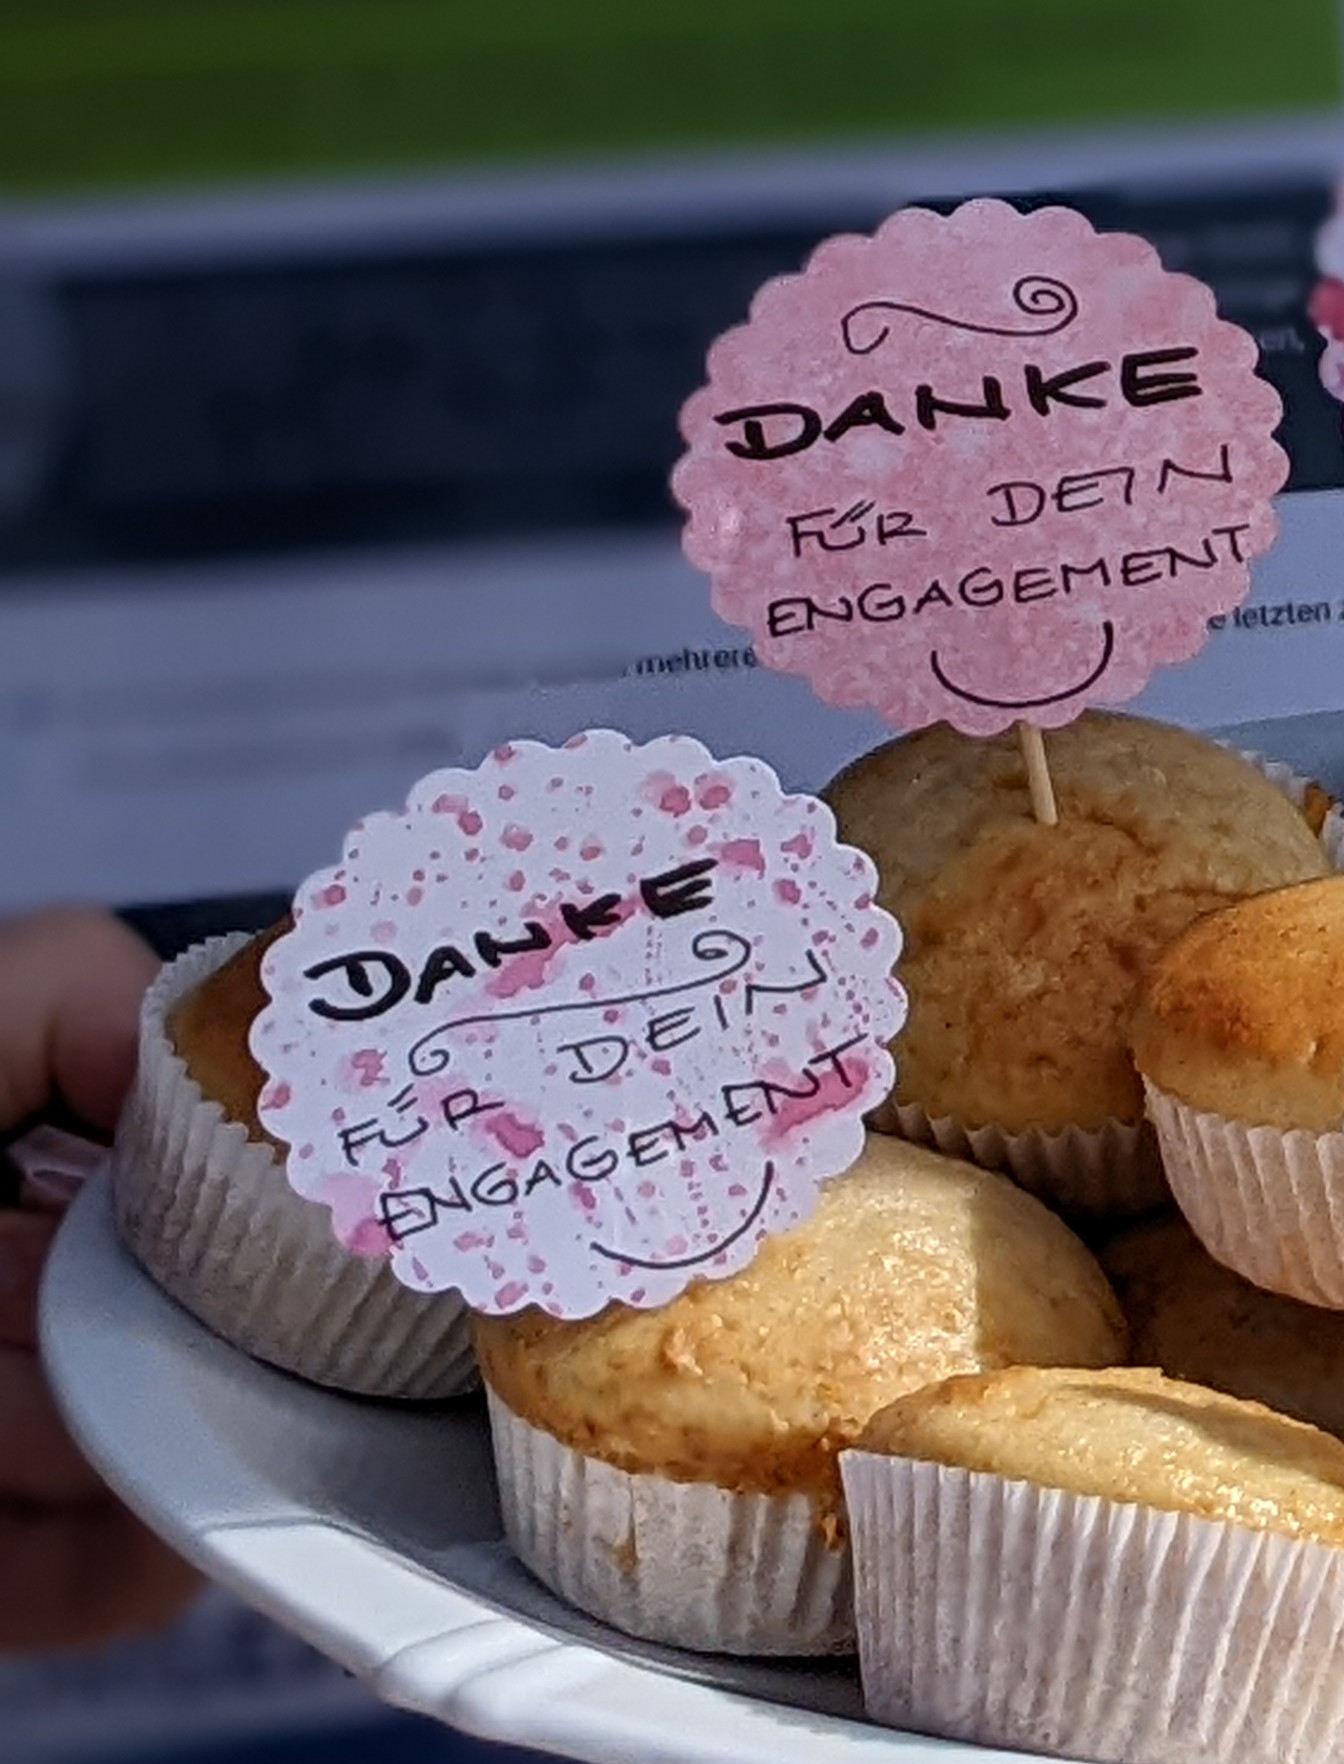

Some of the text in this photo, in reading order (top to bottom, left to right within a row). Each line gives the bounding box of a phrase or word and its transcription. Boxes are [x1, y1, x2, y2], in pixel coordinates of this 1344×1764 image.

[713, 346, 1203, 460] DANKE
[787, 444, 1234, 557] FÜR DEIN
[766, 524, 1251, 639] ENGAGEMENT
[303, 857, 718, 1022] DANKE
[337, 949, 828, 1166] FÜR DEIN
[377, 1033, 869, 1242] ENGAGEMENT
